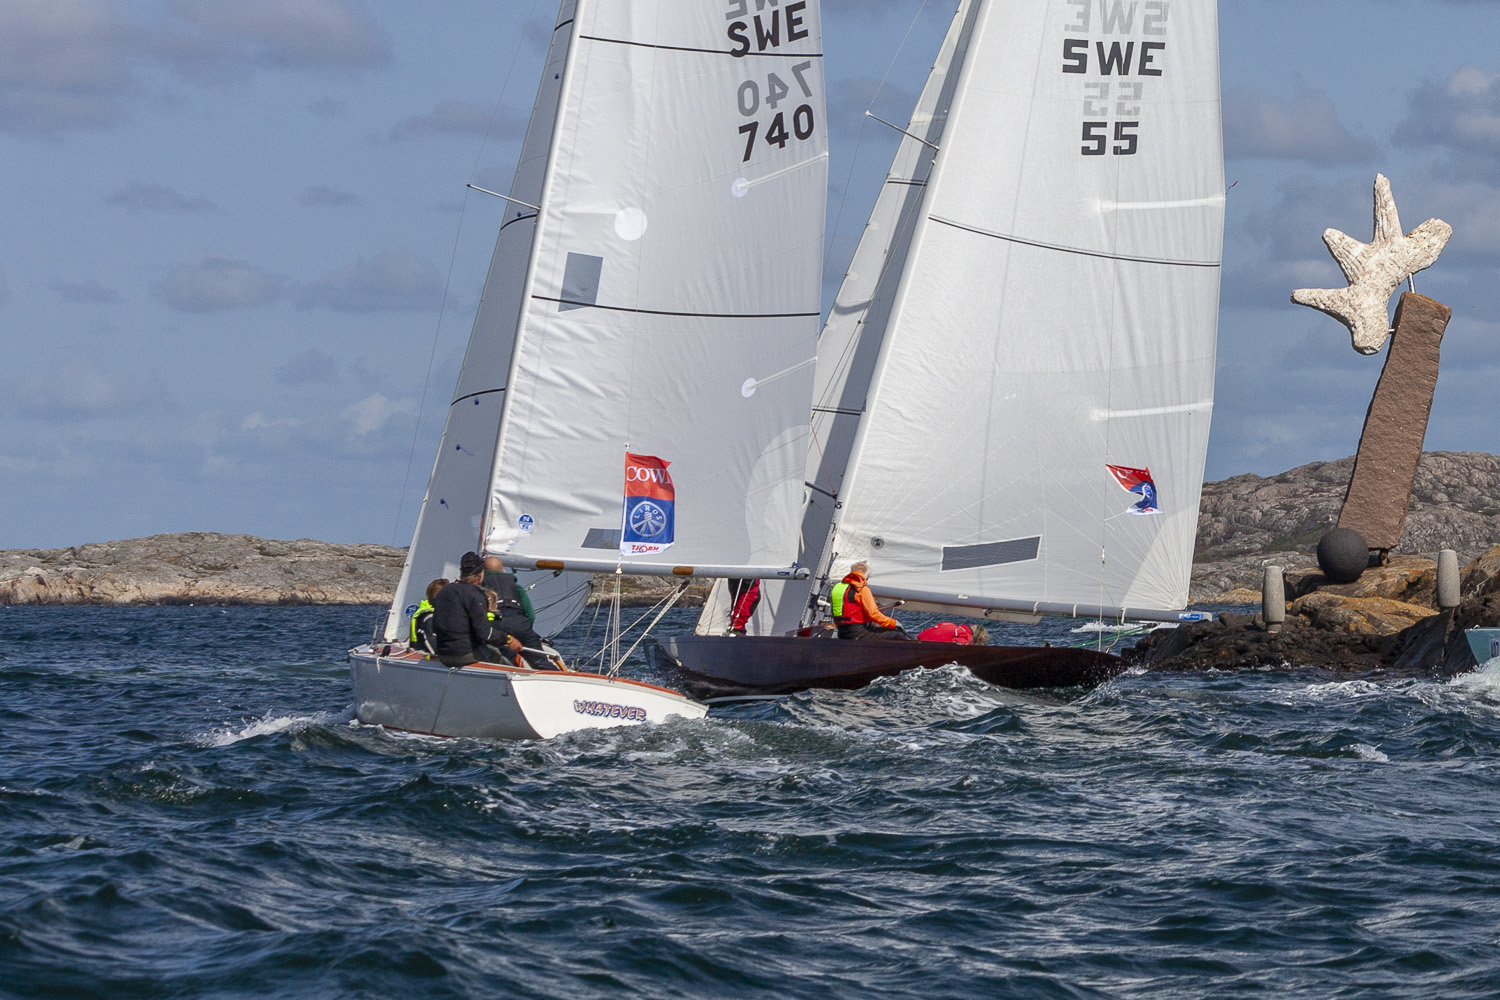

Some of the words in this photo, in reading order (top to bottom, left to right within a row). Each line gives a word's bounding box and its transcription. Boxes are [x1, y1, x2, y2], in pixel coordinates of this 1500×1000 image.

[727, 1, 809, 58] SWE
[1062, 39, 1165, 76] SWE
[738, 104, 815, 163] 740
[1081, 122, 1139, 155] 55
[634, 505, 662, 520] LIROS
[574, 700, 647, 722] WHATEVER
